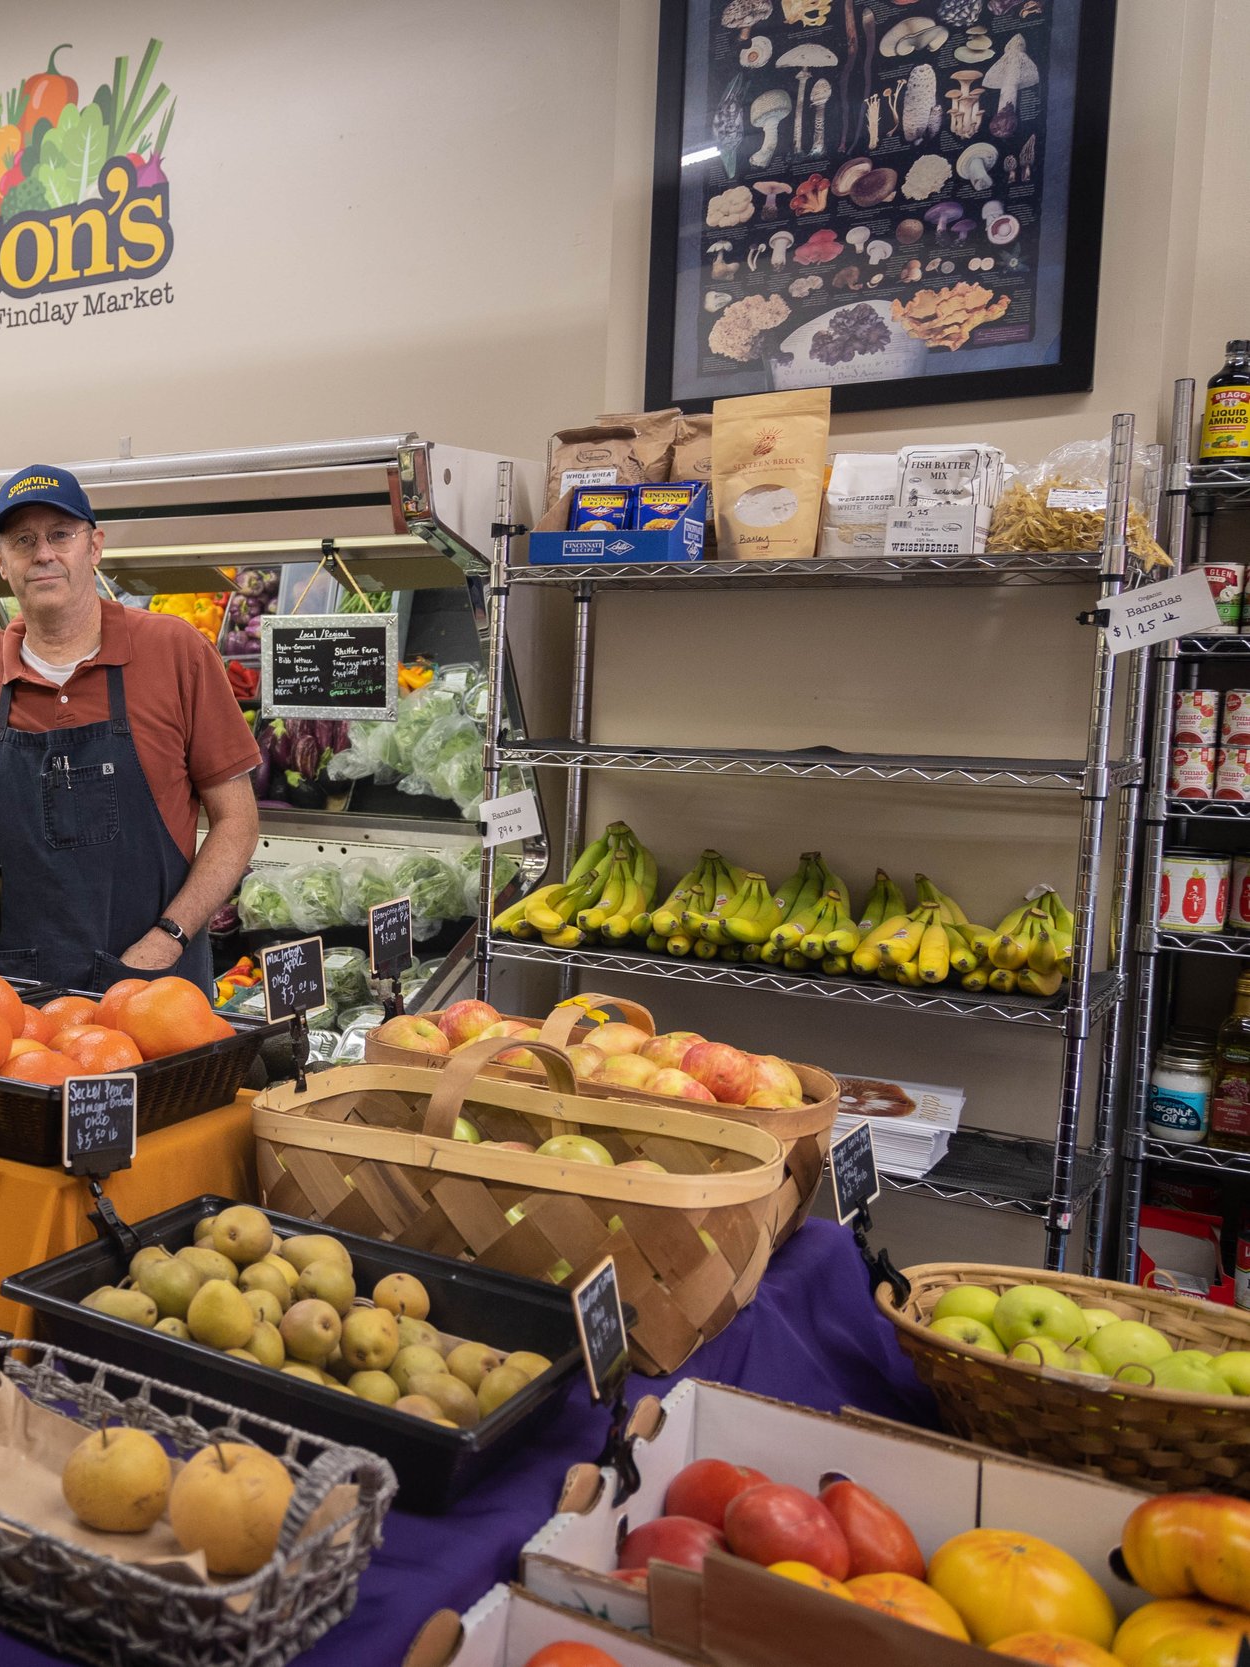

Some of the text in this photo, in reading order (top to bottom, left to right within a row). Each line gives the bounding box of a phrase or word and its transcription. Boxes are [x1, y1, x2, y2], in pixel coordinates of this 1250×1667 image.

[83, 282, 174, 317] Market
[1215, 391, 1247, 400] BRAGG
[1211, 409, 1247, 417] LIQUID
[1208, 416, 1249, 425] AMINOS
[912, 461, 971, 470] FISH BATTER
[930, 472, 948, 480] MIX
[7, 476, 60, 498] SNOWVILLE
[16, 485, 49, 495] CREAMERY
[838, 494, 895, 502] WEISENBERGER
[891, 543, 959, 553] WEISENBERGER
[1209, 568, 1232, 578] GLEN
[1138, 591, 1162, 602] Organic
[1125, 594, 1183, 618] Bananas
[1113, 619, 1156, 639] $1.25
[491, 807, 522, 820] Bananas
[105, 1080, 127, 1099] Pear
[108, 1128, 119, 1142] lb
